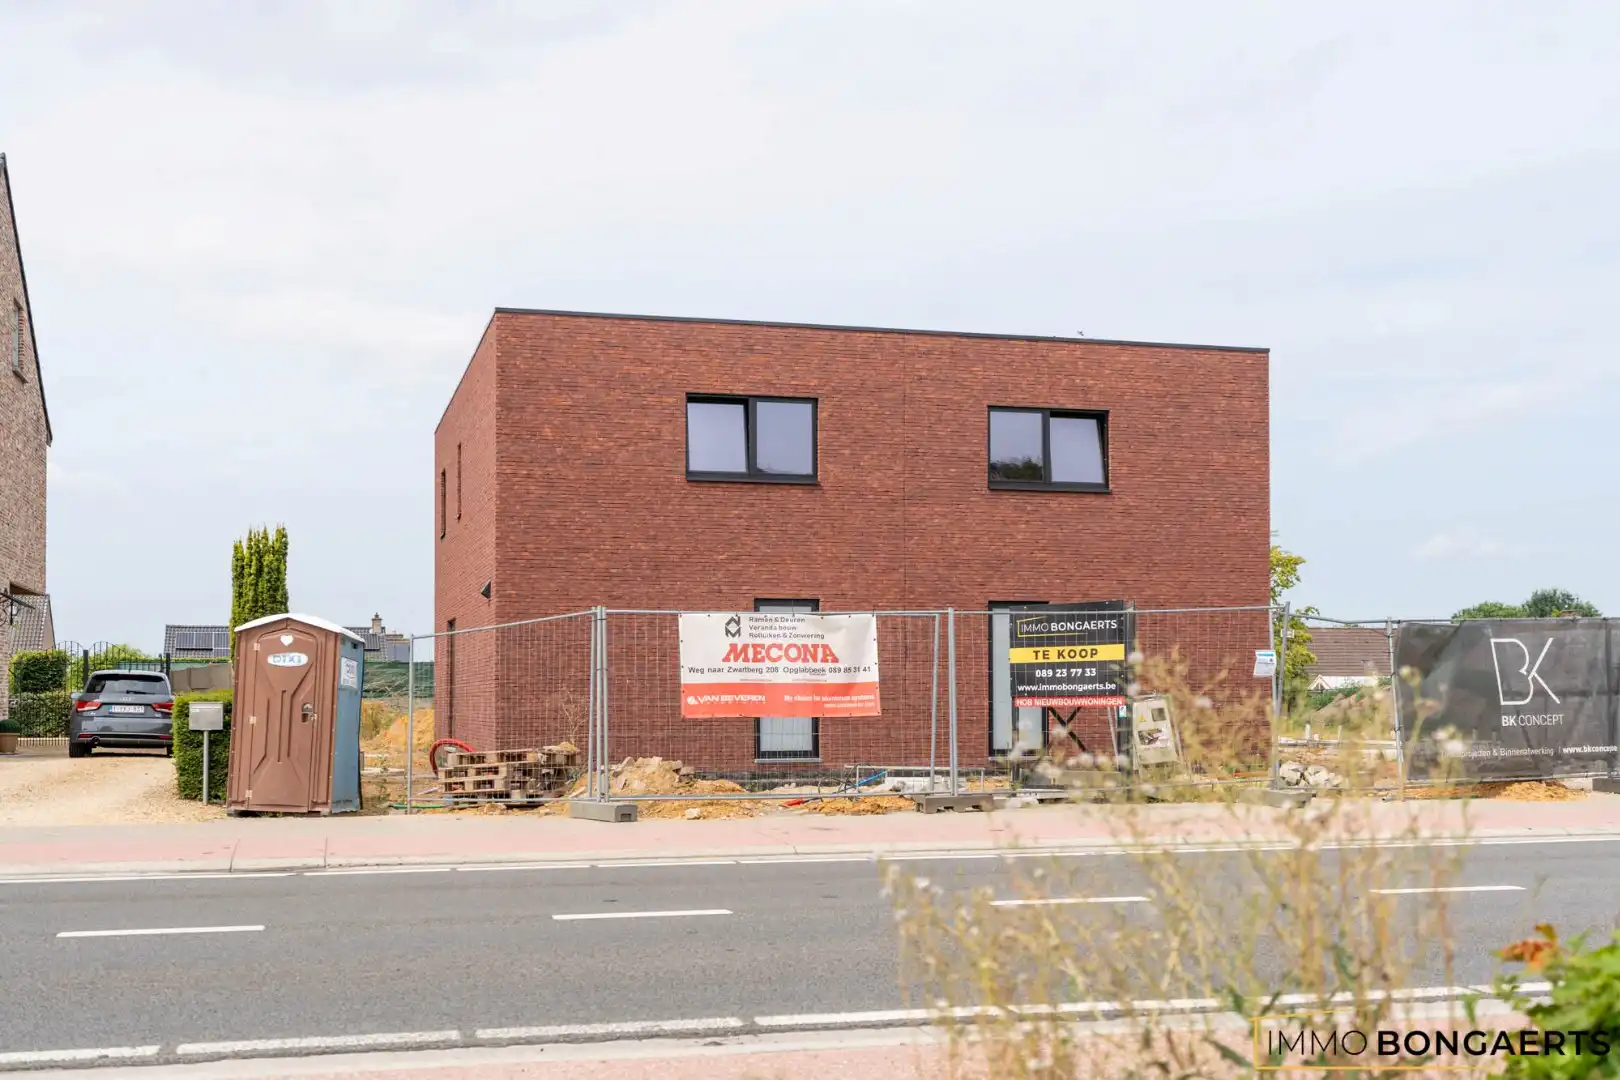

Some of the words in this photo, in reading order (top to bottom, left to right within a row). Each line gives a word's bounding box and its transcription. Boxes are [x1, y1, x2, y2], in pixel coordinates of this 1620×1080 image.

[1021, 622, 1048, 632] IMMO
[1051, 620, 1118, 632] BONGAERTS
[722, 643, 840, 663] MECONA
[1032, 650, 1050, 660] TE
[1057, 648, 1098, 660] KOOP
[727, 666, 763, 674] Zwartberg
[782, 666, 826, 674] Opglabbeek
[1036, 669, 1053, 678] 089
[1056, 668, 1068, 678] 23
[1070, 668, 1082, 677] 77
[1084, 668, 1096, 676] 33
[1018, 682, 1116, 692] www.immobongaerts.be
[697, 695, 719, 703] VAN
[1502, 715, 1518, 728] BK
[1518, 714, 1564, 726] CONCEPT
[1492, 748, 1498, 756] &
